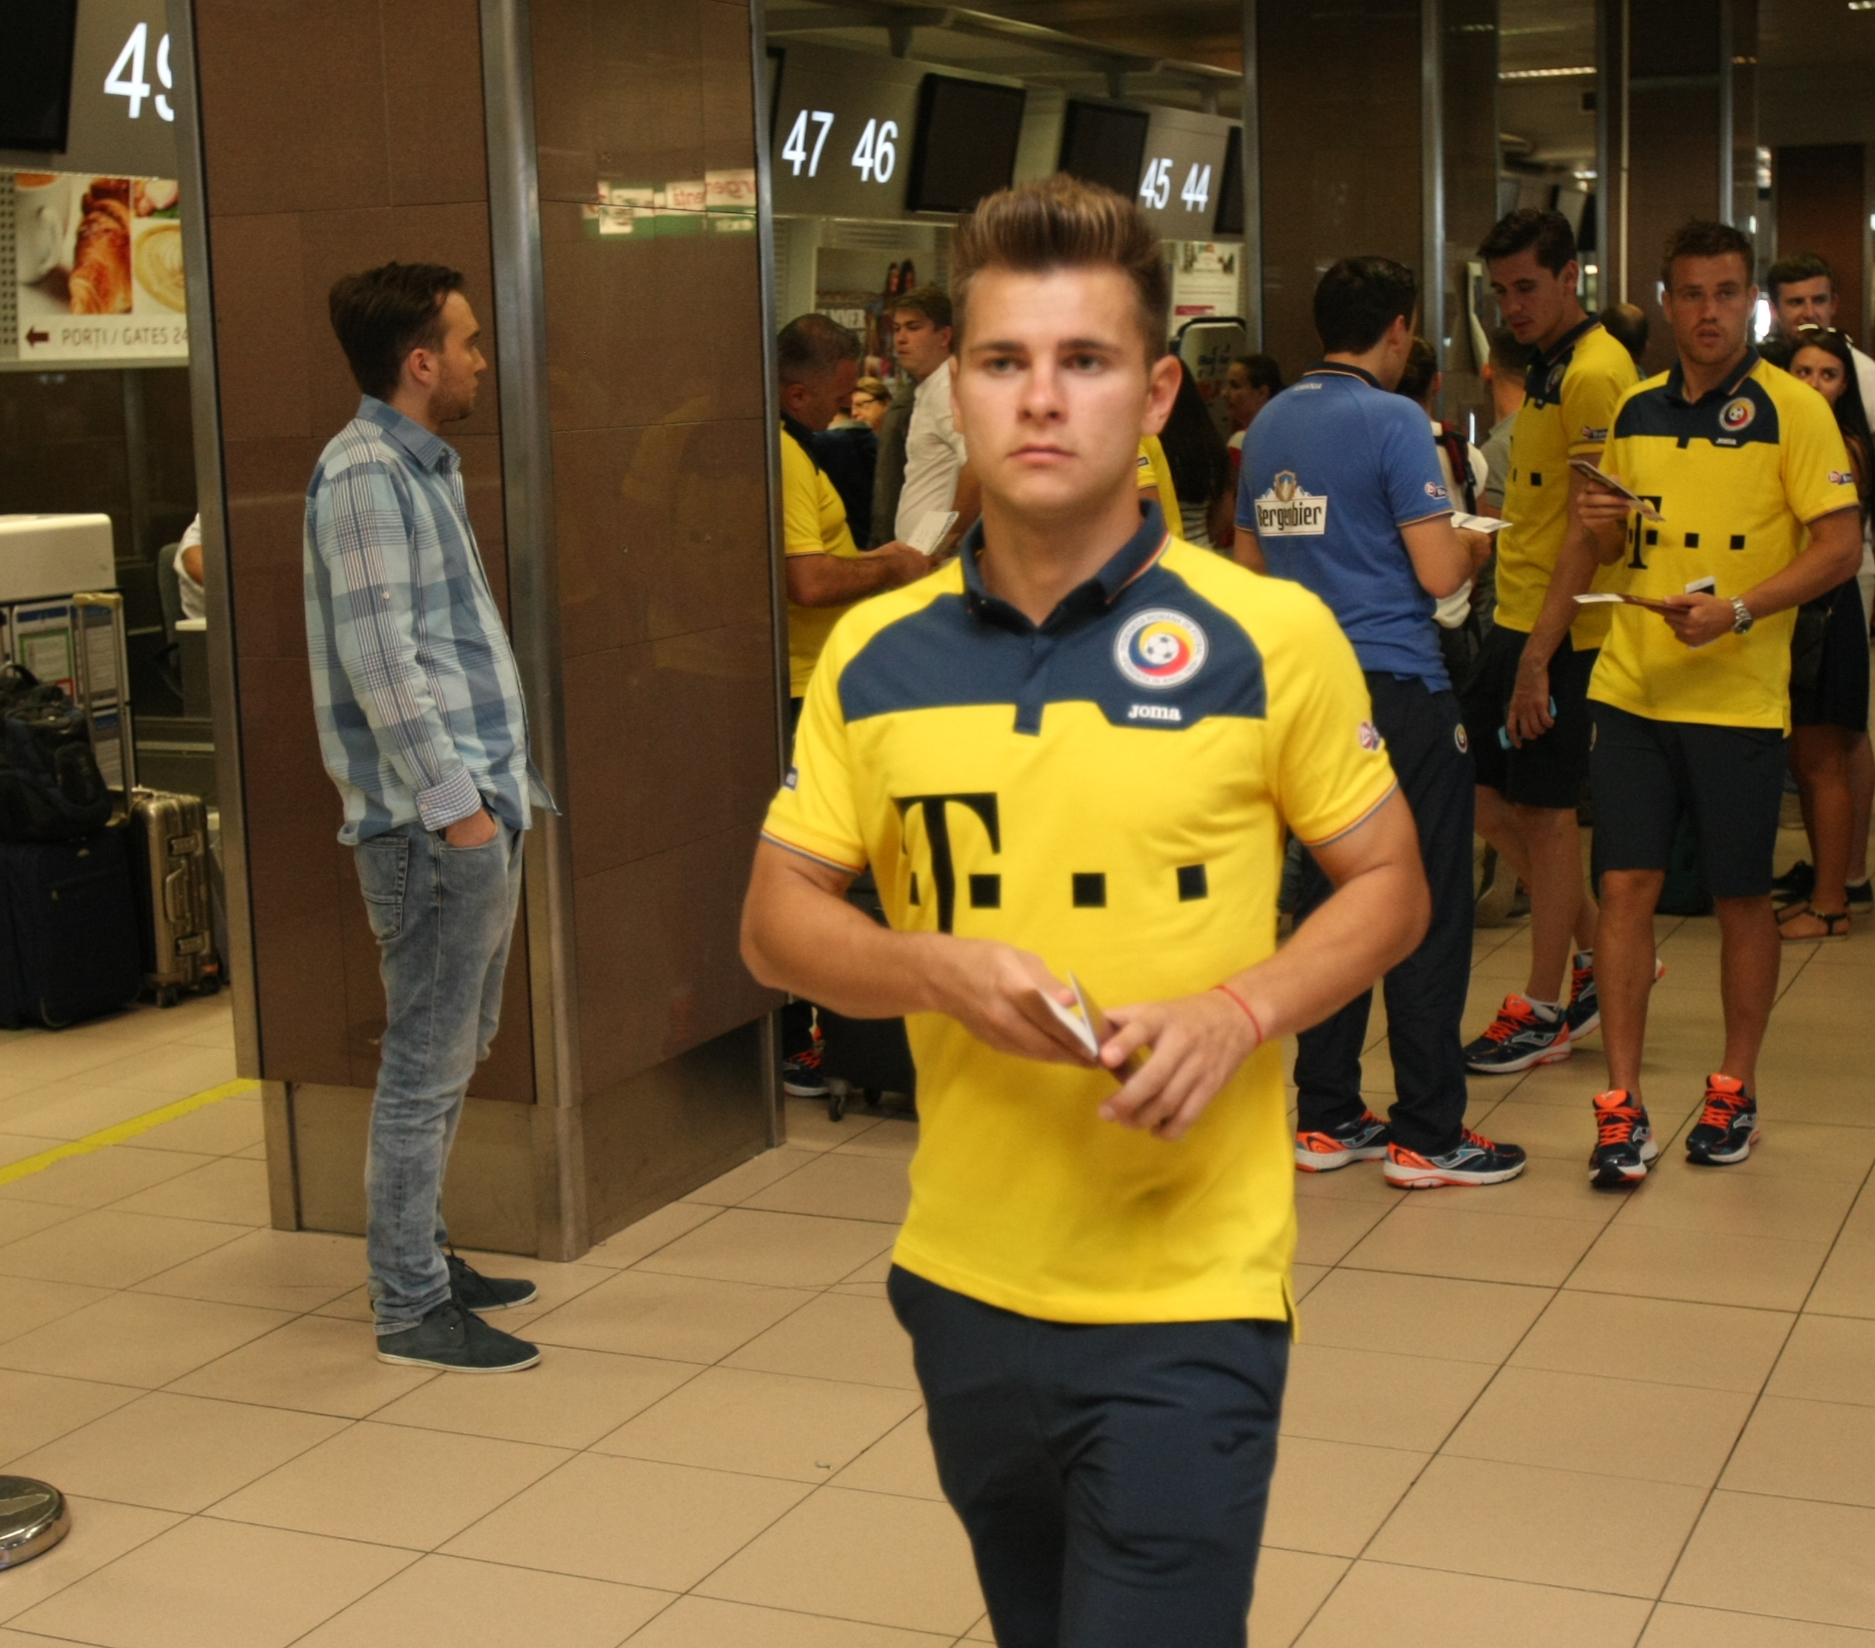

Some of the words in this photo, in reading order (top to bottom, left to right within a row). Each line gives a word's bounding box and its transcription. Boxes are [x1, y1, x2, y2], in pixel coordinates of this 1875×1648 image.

[782, 109, 835, 178] 47
[851, 118, 899, 184] 46
[1140, 157, 1174, 210] 45
[1181, 162, 1211, 213] 44
[122, 326, 168, 346] GATES
